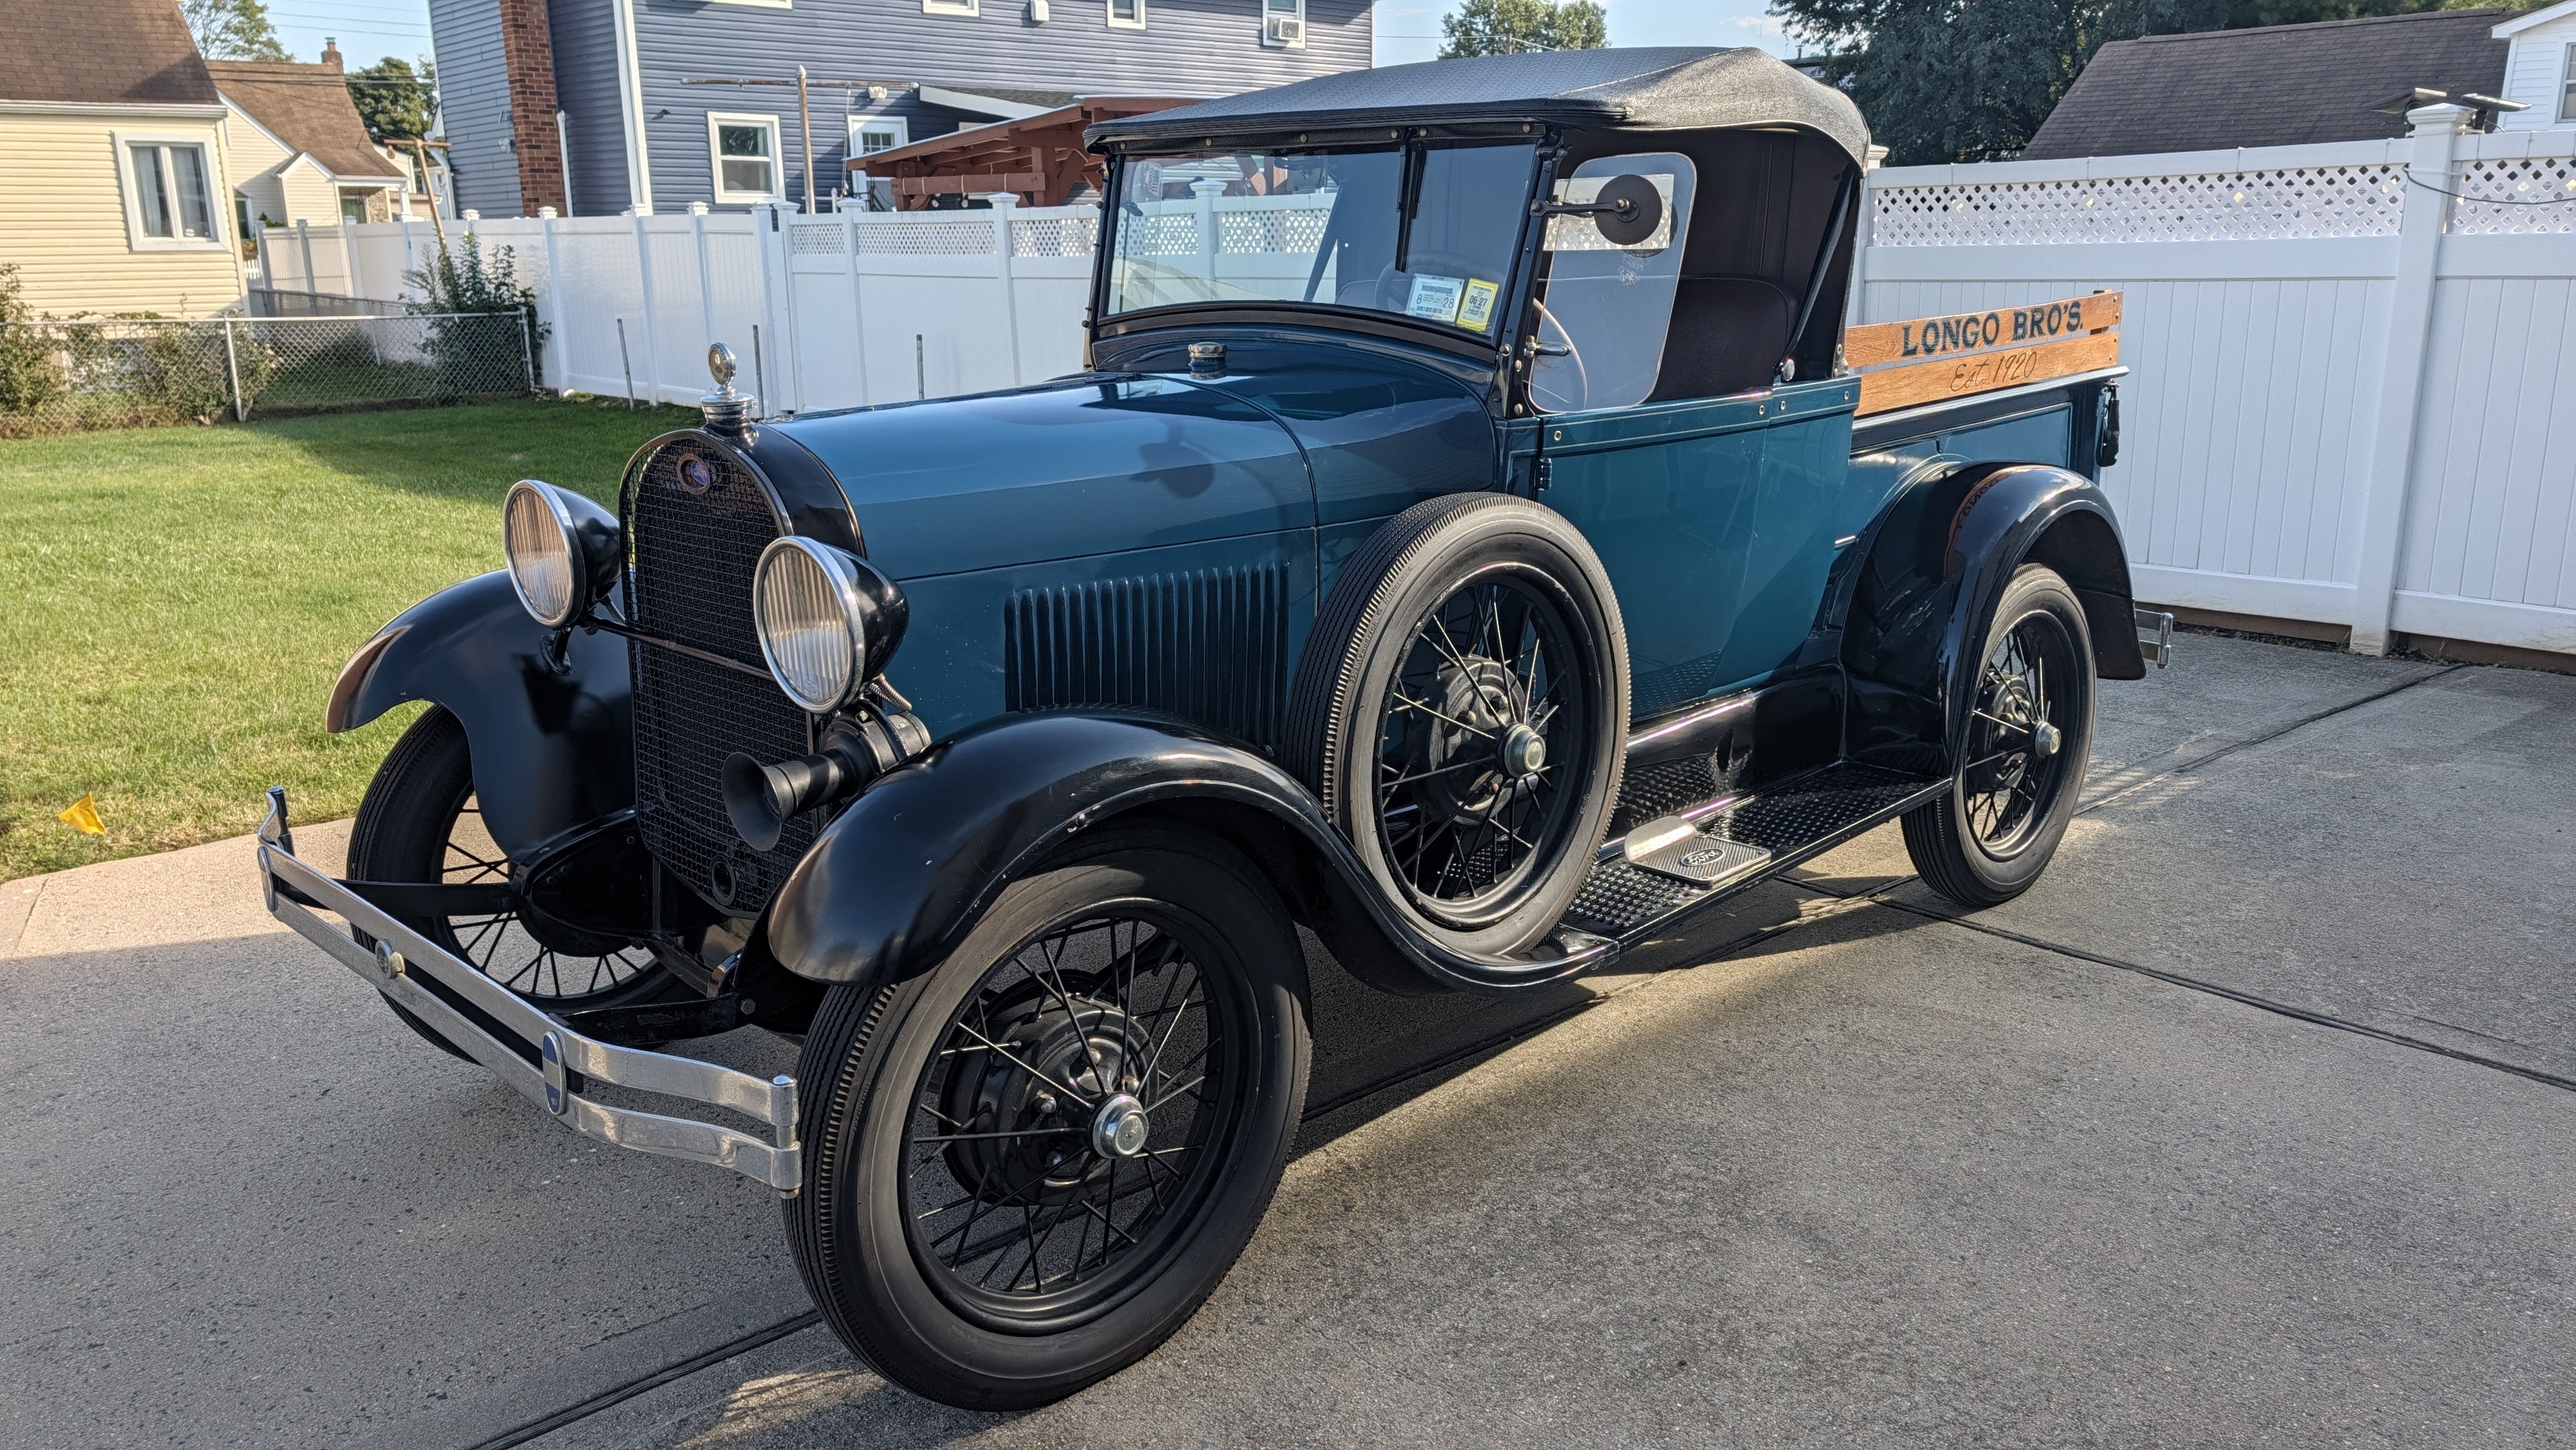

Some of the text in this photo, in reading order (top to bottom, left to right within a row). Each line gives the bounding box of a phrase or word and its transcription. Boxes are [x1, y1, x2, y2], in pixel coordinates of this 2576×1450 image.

[1416, 293, 1423, 304] 8
[1443, 297, 1455, 309] 28
[1901, 311, 2000, 358] LONGO
[1992, 351, 2037, 385] 1920
